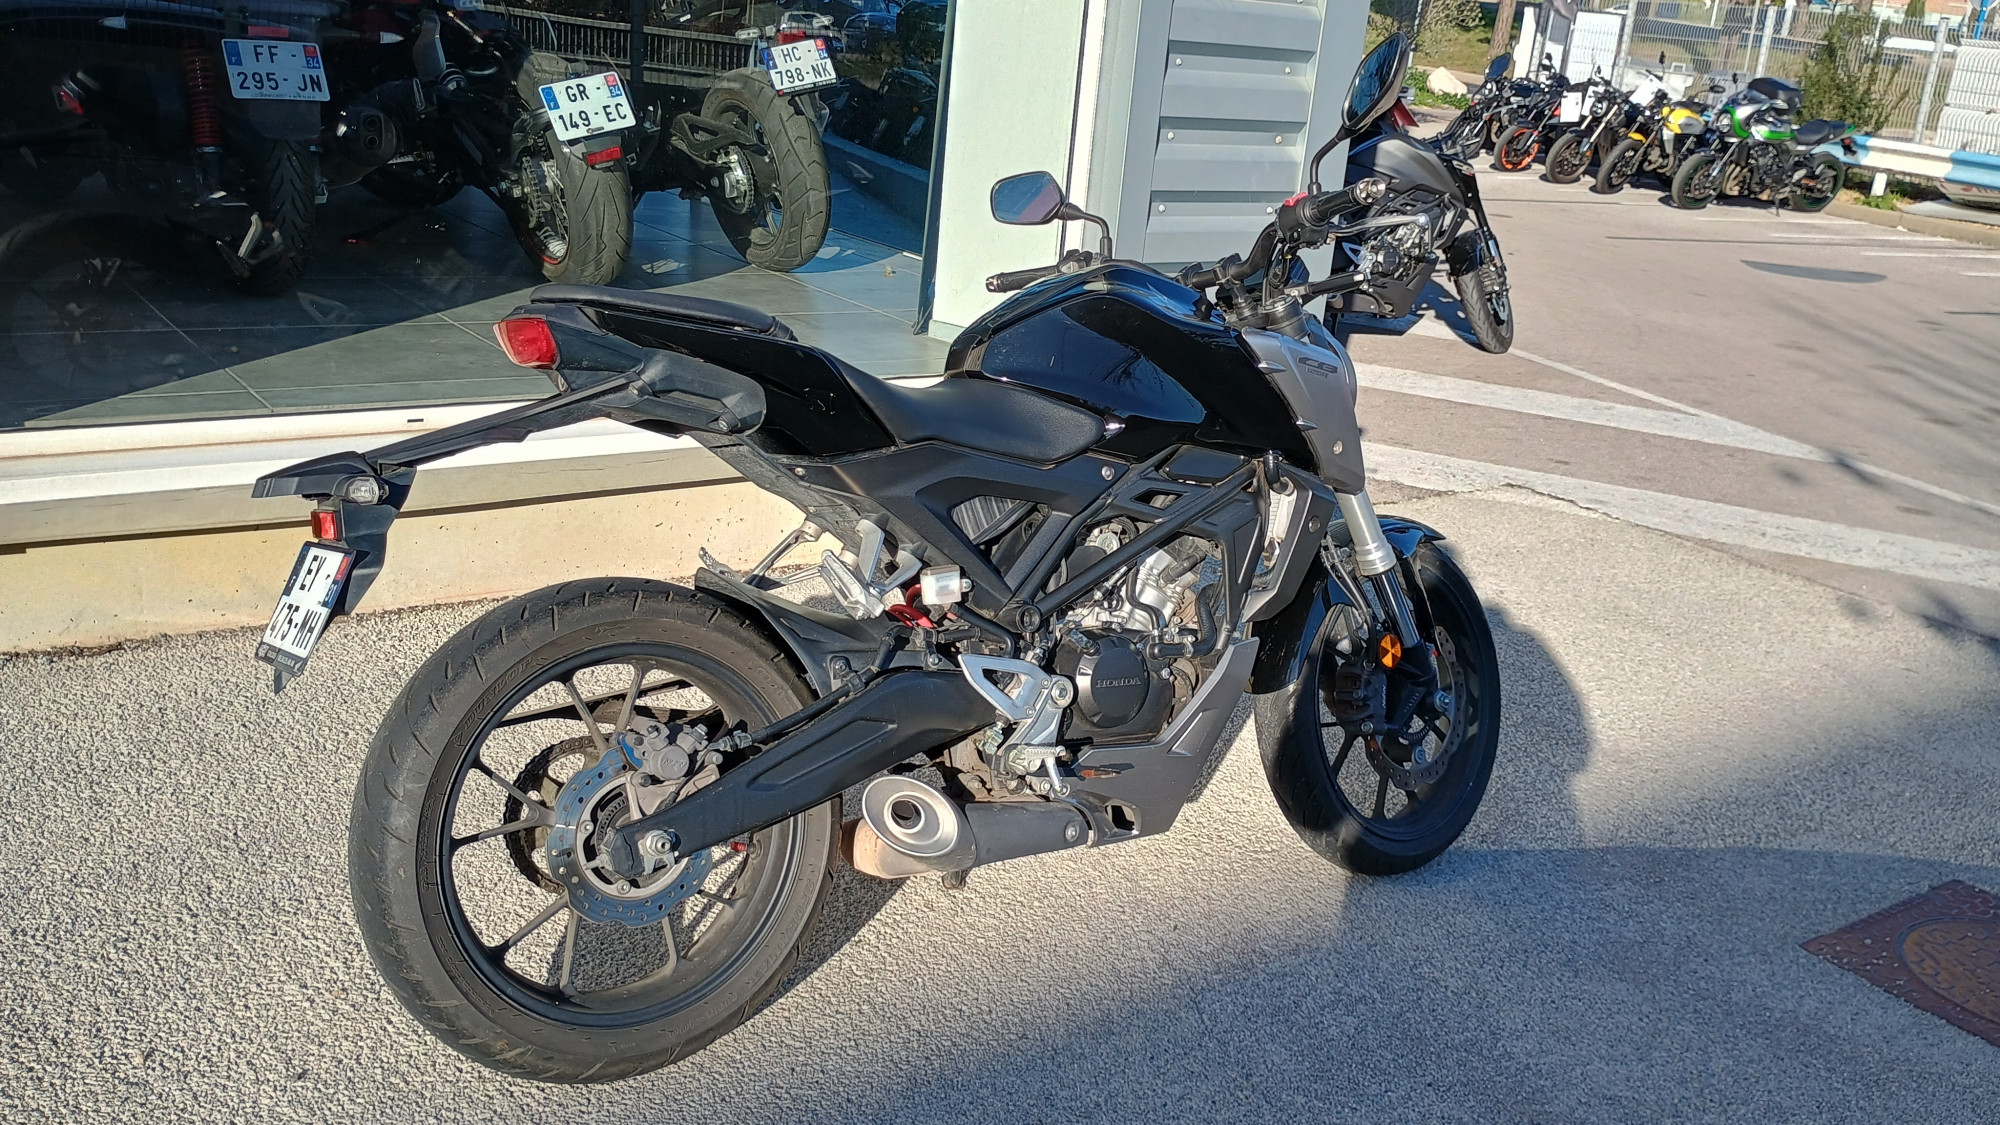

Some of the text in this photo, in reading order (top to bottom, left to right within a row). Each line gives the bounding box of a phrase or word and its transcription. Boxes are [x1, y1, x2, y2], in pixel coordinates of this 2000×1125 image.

[253, 45, 279, 63] FF
[306, 57, 319, 68] 34
[781, 46, 801, 63] HC
[565, 83, 590, 102] GR
[609, 85, 621, 97] 34
[299, 555, 327, 592] EY
[1096, 677, 1141, 688] HONDA
[463, 656, 533, 730] DUNLOP
